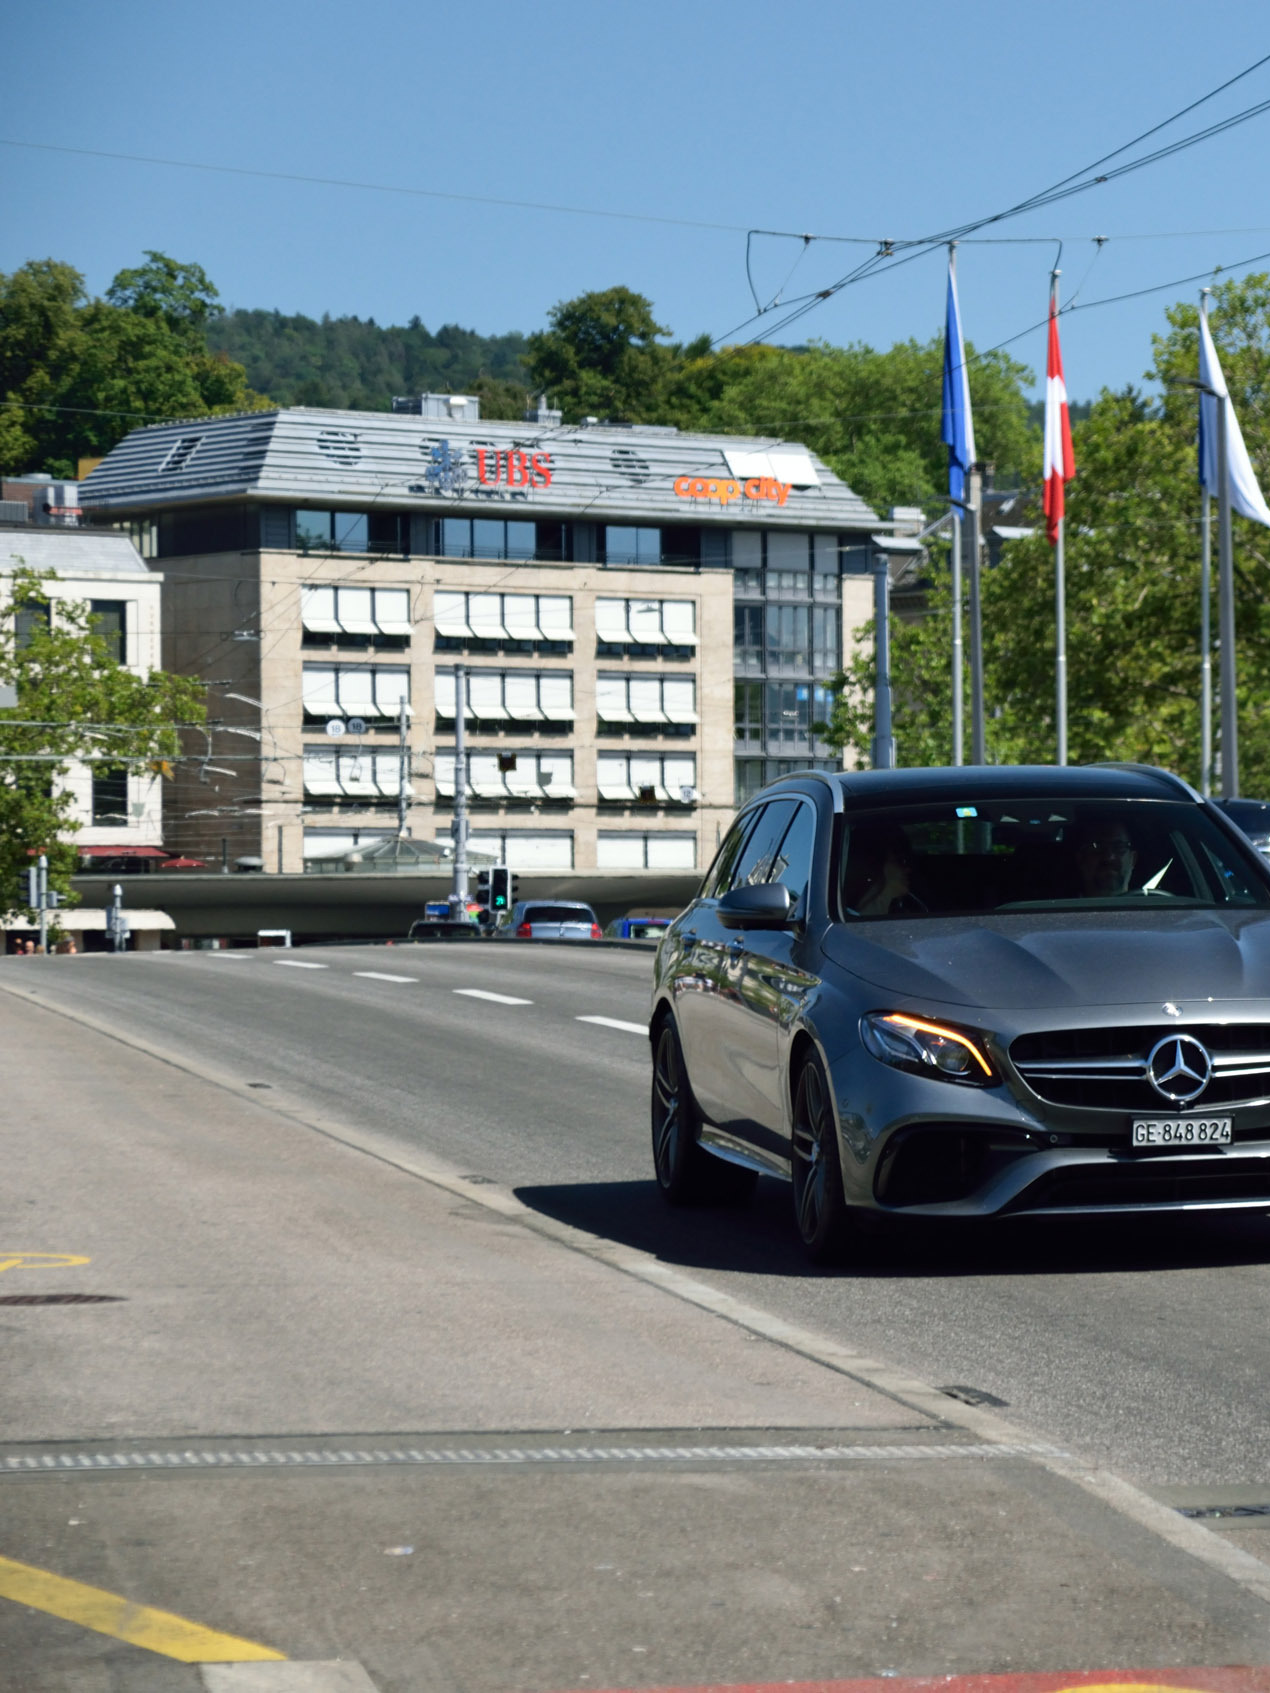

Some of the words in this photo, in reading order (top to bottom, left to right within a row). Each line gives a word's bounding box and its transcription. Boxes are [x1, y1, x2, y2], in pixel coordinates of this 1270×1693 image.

[475, 448, 552, 488] UBS
[674, 476, 741, 505] coop
[744, 476, 792, 506] city
